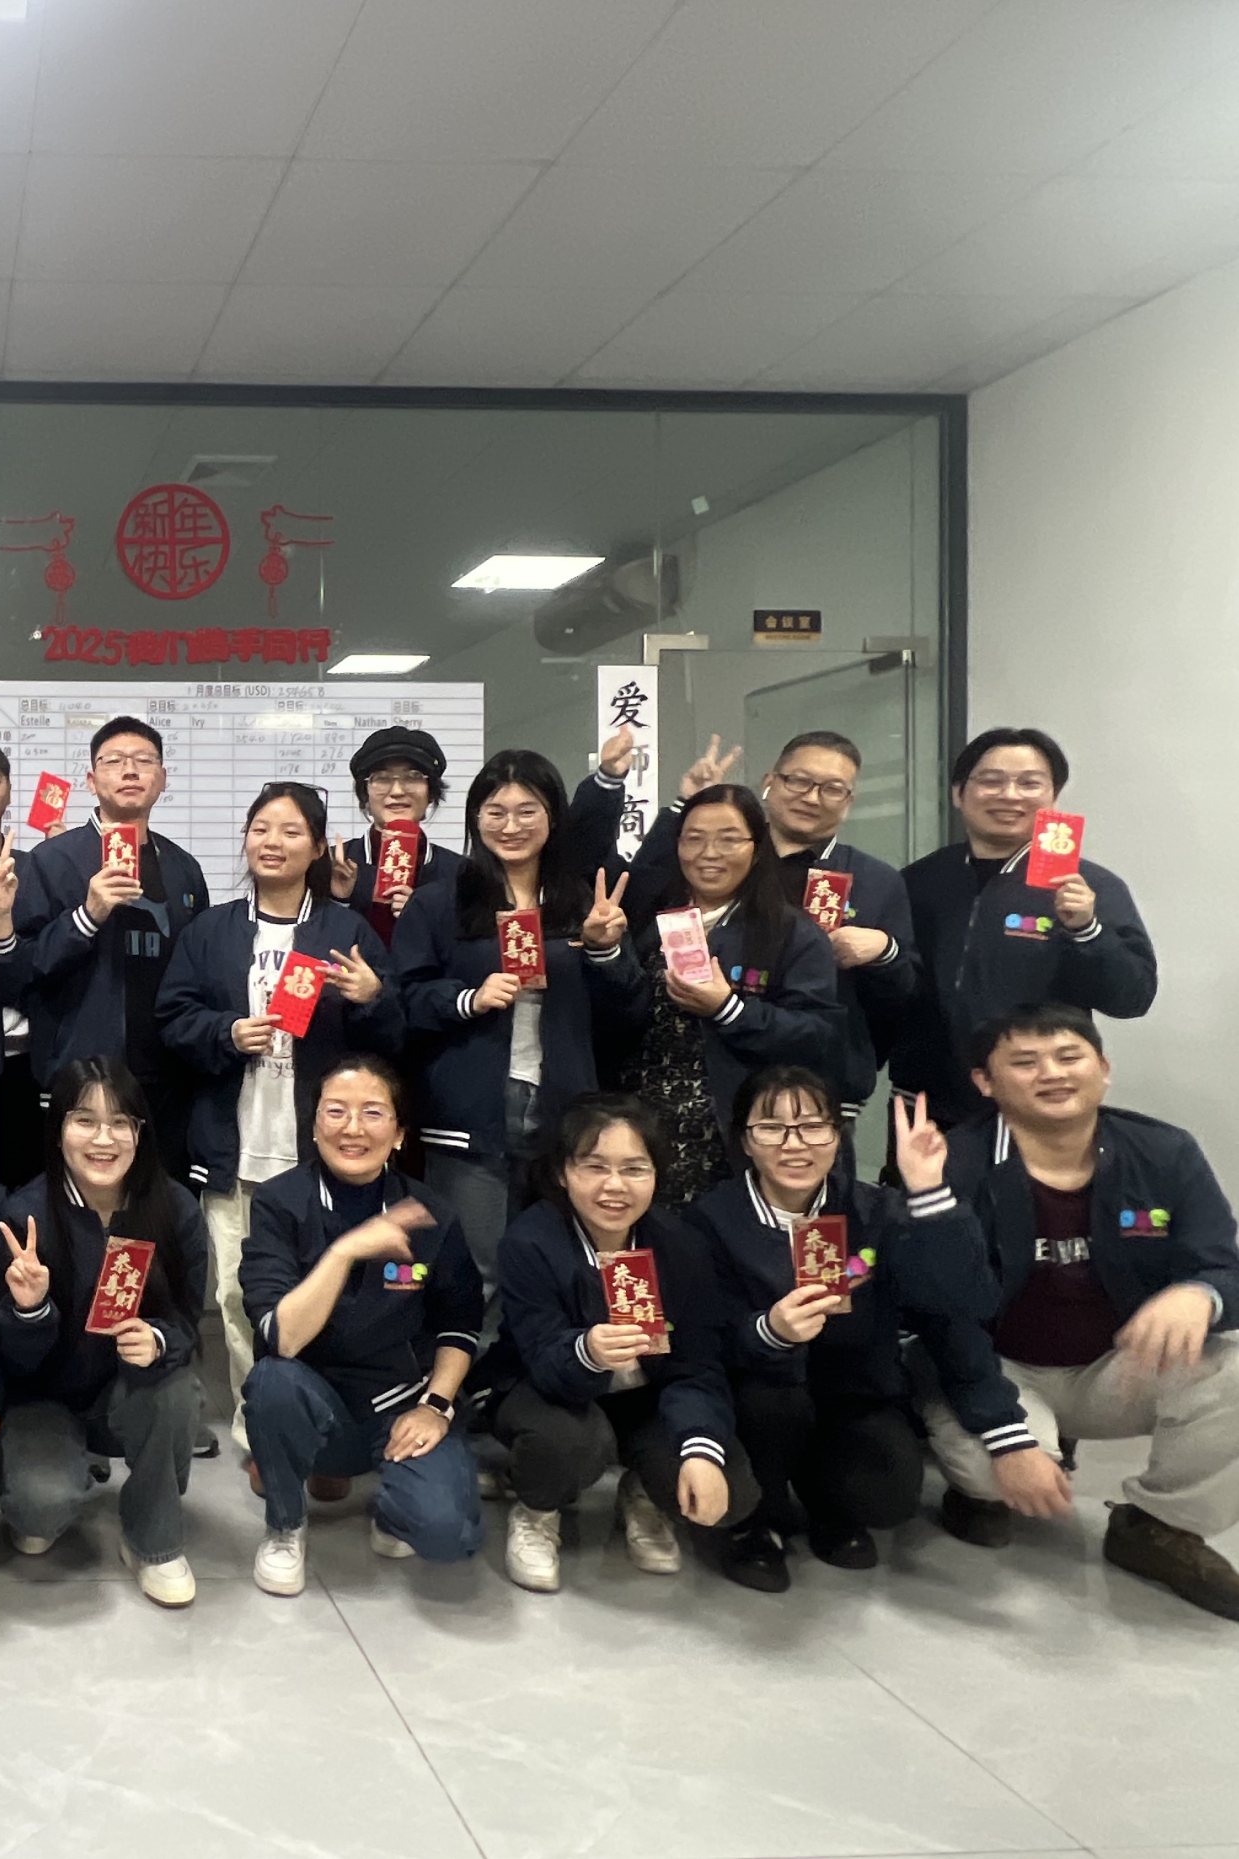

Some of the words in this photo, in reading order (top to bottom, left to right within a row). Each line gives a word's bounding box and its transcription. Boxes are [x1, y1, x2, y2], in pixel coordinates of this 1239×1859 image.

[132, 497, 213, 538] 新年
[132, 543, 213, 588] 快乐
[21, 715, 50, 726] Estelle
[149, 717, 171, 727] Alice
[354, 717, 387, 727] Nathan
[393, 718, 422, 728] Sherry
[610, 681, 650, 859] 爱商
[40, 782, 64, 808] 福
[1038, 822, 1076, 855] 福
[283, 965, 316, 1000] 福
